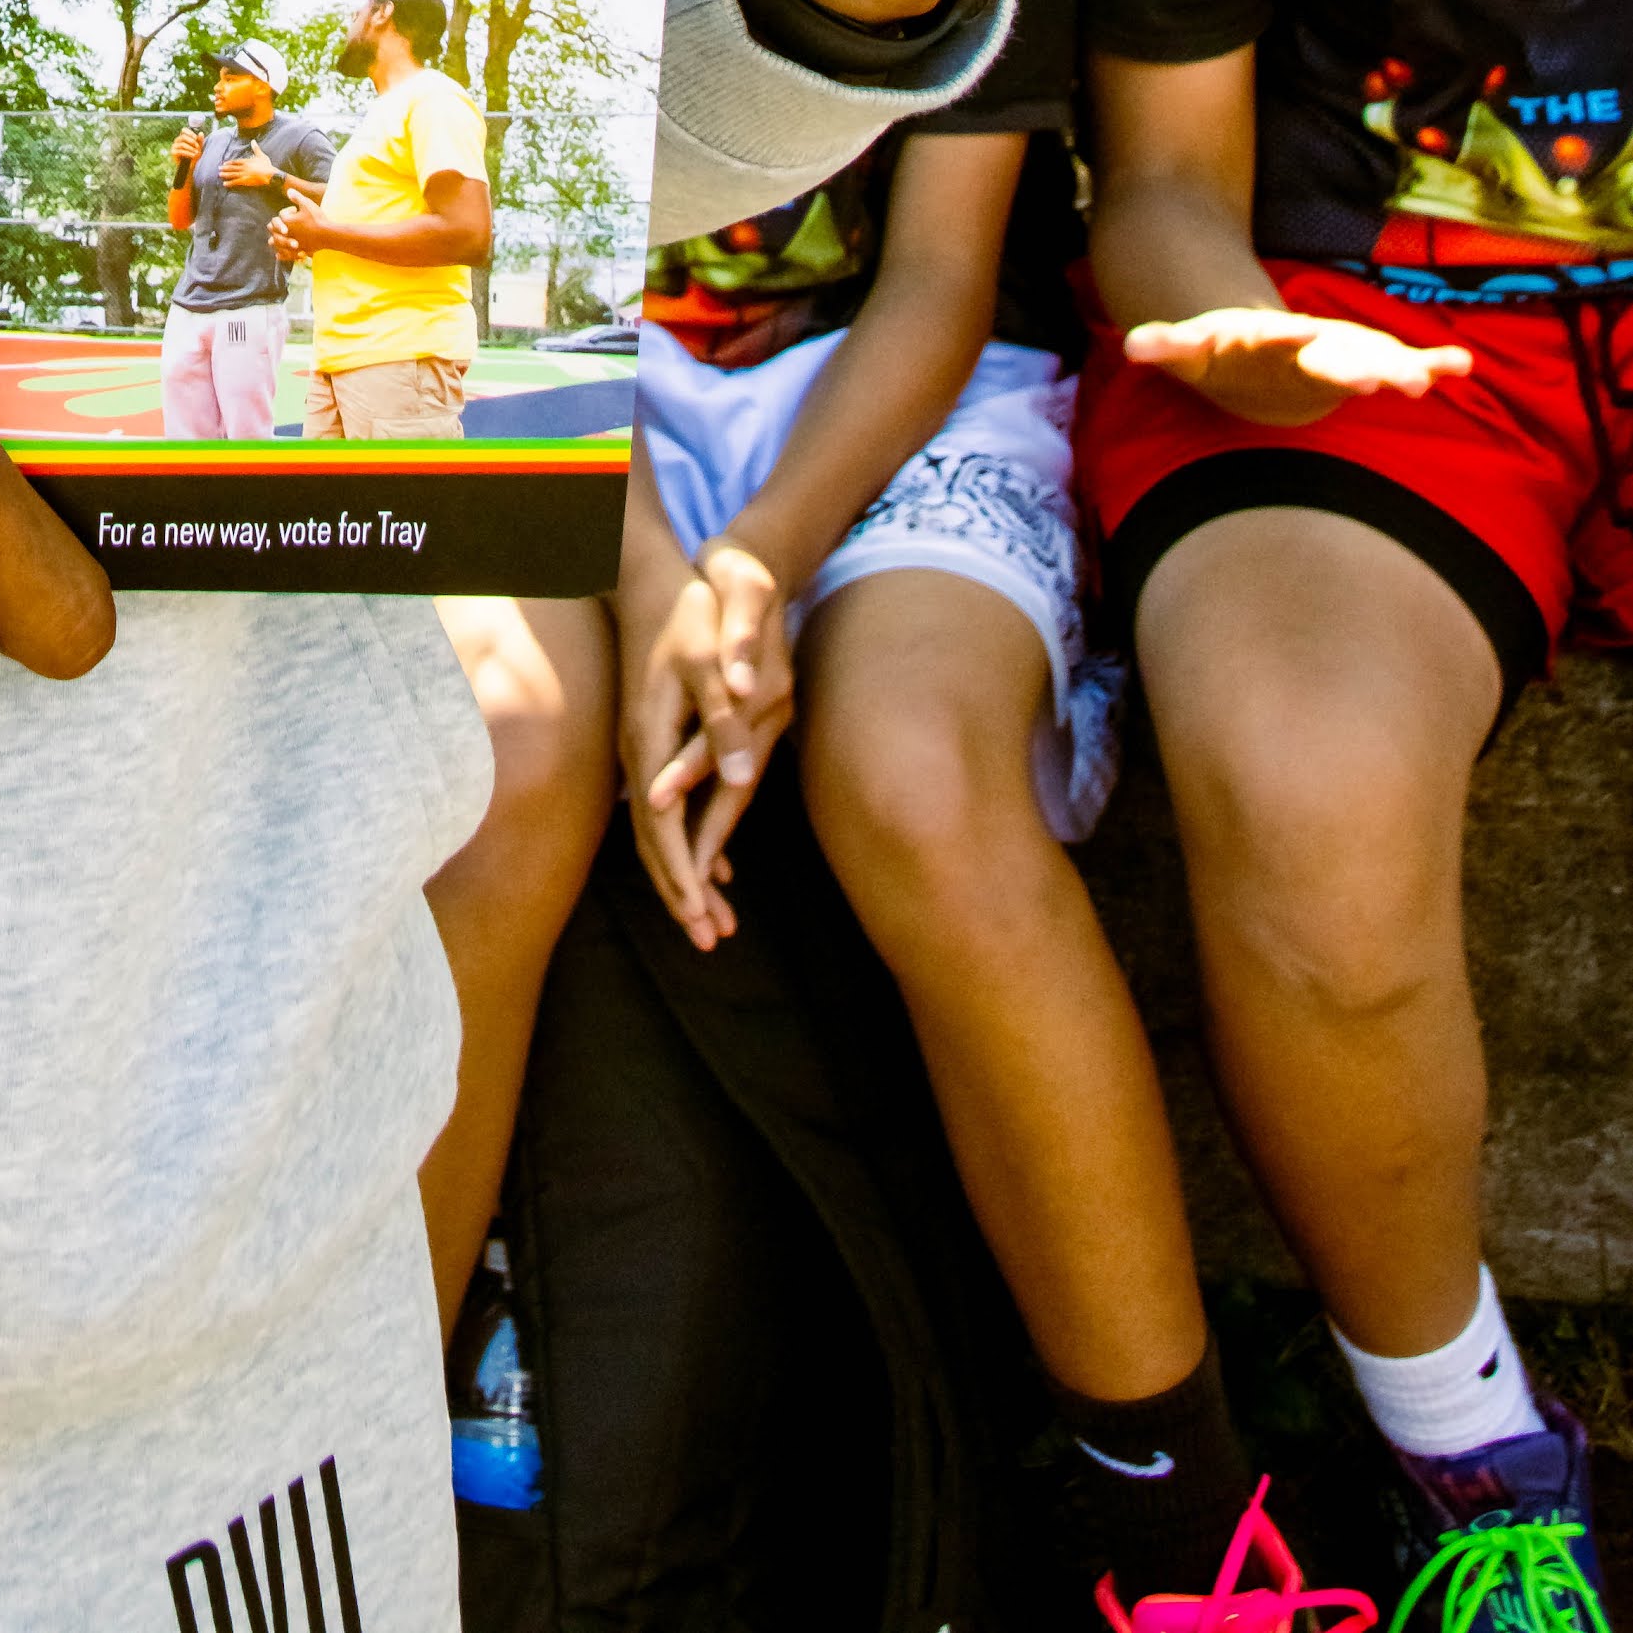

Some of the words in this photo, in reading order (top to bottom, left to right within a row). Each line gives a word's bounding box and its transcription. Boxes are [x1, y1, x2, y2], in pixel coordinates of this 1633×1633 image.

[1508, 88, 1622, 125] THE
[98, 512, 136, 547] For
[142, 522, 156, 547] a
[164, 522, 216, 547] new
[219, 521, 271, 553] way,
[279, 516, 332, 547] vote
[339, 511, 372, 546] for
[378, 511, 427, 552] Tray
